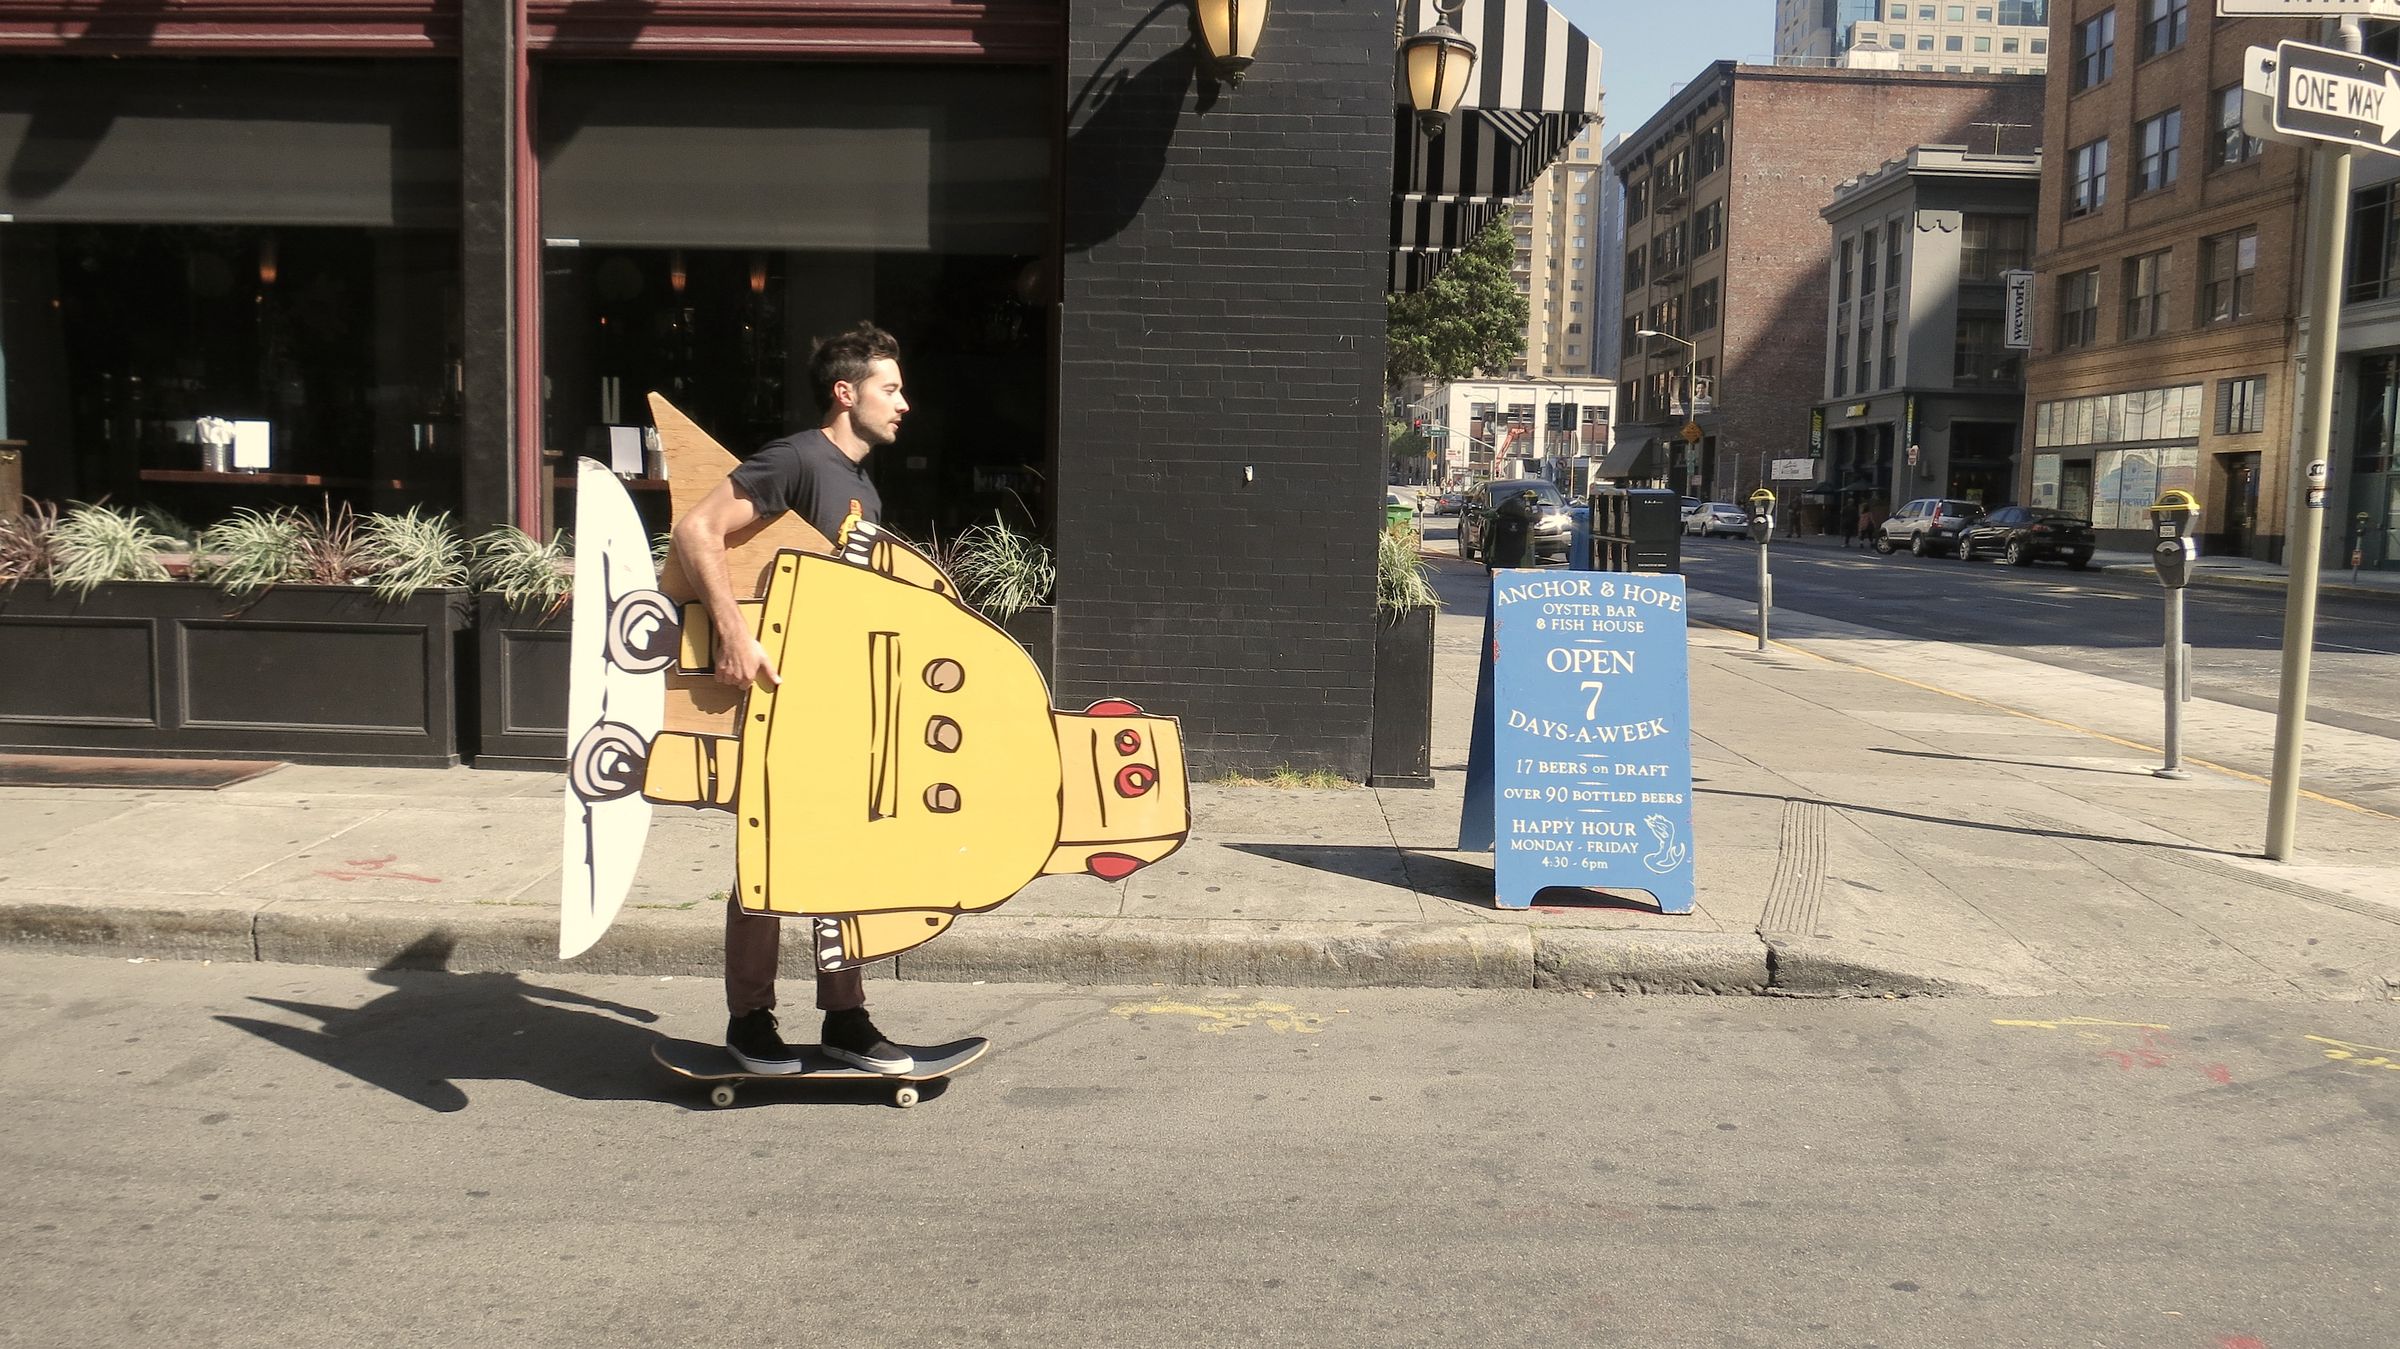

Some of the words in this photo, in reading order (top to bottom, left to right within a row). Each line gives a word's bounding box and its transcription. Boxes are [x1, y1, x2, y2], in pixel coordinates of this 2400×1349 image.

[2295, 73, 2338, 112] ONE
[2347, 83, 2385, 121] WAY
[2012, 279, 2025, 341] wework
[1811, 410, 1823, 449] SUBWAY
[1497, 579, 1592, 607] ANCHOR
[1600, 581, 1615, 598] &
[1622, 583, 1683, 613] HOPE
[1542, 602, 1601, 617] OYSTER
[1606, 605, 1637, 618] BAR
[1535, 617, 1547, 630] &
[1551, 618, 1585, 631] FISH
[1592, 619, 1645, 633] HOUSE
[1546, 648, 1636, 674] OPEN
[1580, 680, 1604, 721] 7
[1516, 758, 1534, 775] 17
[1538, 761, 1588, 775] BEERS
[1592, 764, 1609, 775] on
[1614, 763, 1670, 777] DRAFT
[1503, 788, 1542, 800] OVER
[1545, 786, 1569, 803] 90
[1572, 790, 1637, 803] BOTTLED
[1641, 792, 1683, 805] BEERS
[1512, 819, 1575, 835] HAPPY
[1581, 821, 1637, 837] HOUR
[1510, 839, 1574, 852] MONDAY
[1586, 840, 1640, 854] FRIDAY
[1581, 857, 1609, 871] 6pm
